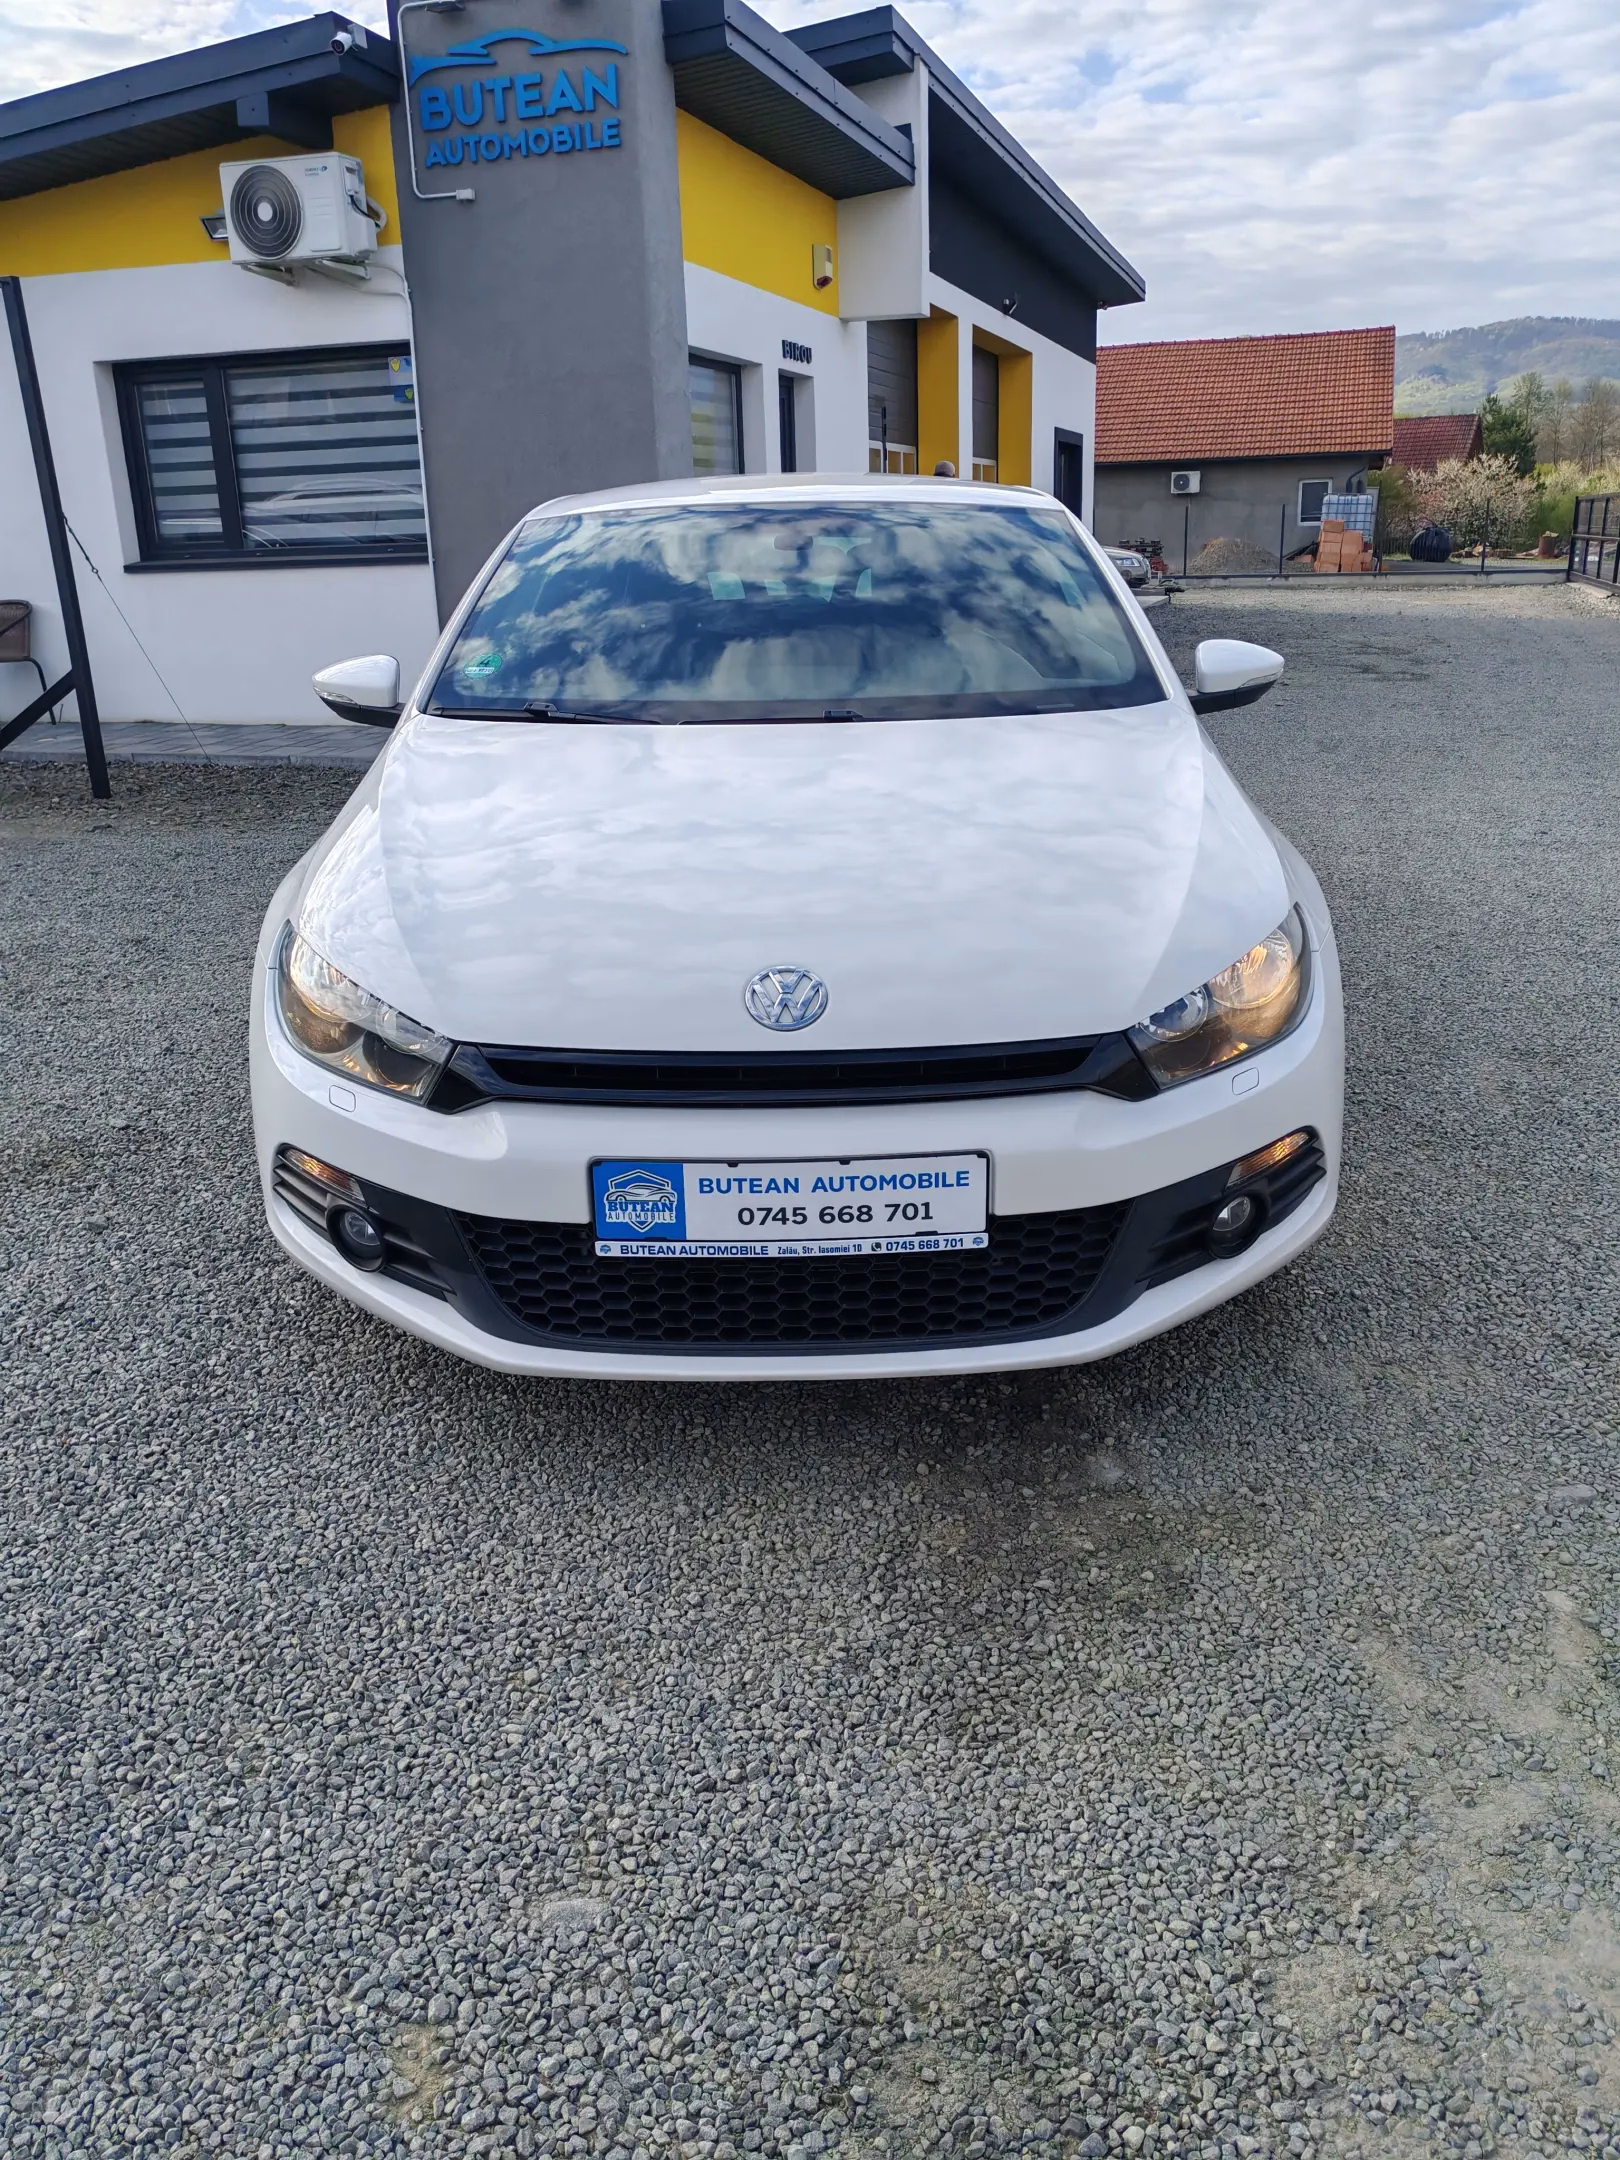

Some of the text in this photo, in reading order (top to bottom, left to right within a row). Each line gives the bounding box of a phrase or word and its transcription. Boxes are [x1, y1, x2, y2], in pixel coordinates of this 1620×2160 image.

[419, 63, 619, 132] BUTEAN
[425, 117, 622, 168] AUTOMOBILE
[781, 339, 813, 365] BIROU
[479, 655, 492, 667] 4
[698, 1170, 970, 1194] BUTEAN AUTOMOBILE
[607, 1201, 674, 1212] BUTEAN
[608, 1212, 675, 1221] AUTOMOBILE
[738, 1201, 934, 1226] 0745 668 701
[620, 1244, 677, 1256] BUTEAN
[678, 1245, 769, 1256] AUTOMOBILE
[802, 1245, 817, 1255] Str.
[818, 1243, 851, 1254] Iasomiei
[885, 1240, 915, 1252] 0745
[918, 1239, 940, 1250] 668
[942, 1237, 964, 1249] 701
